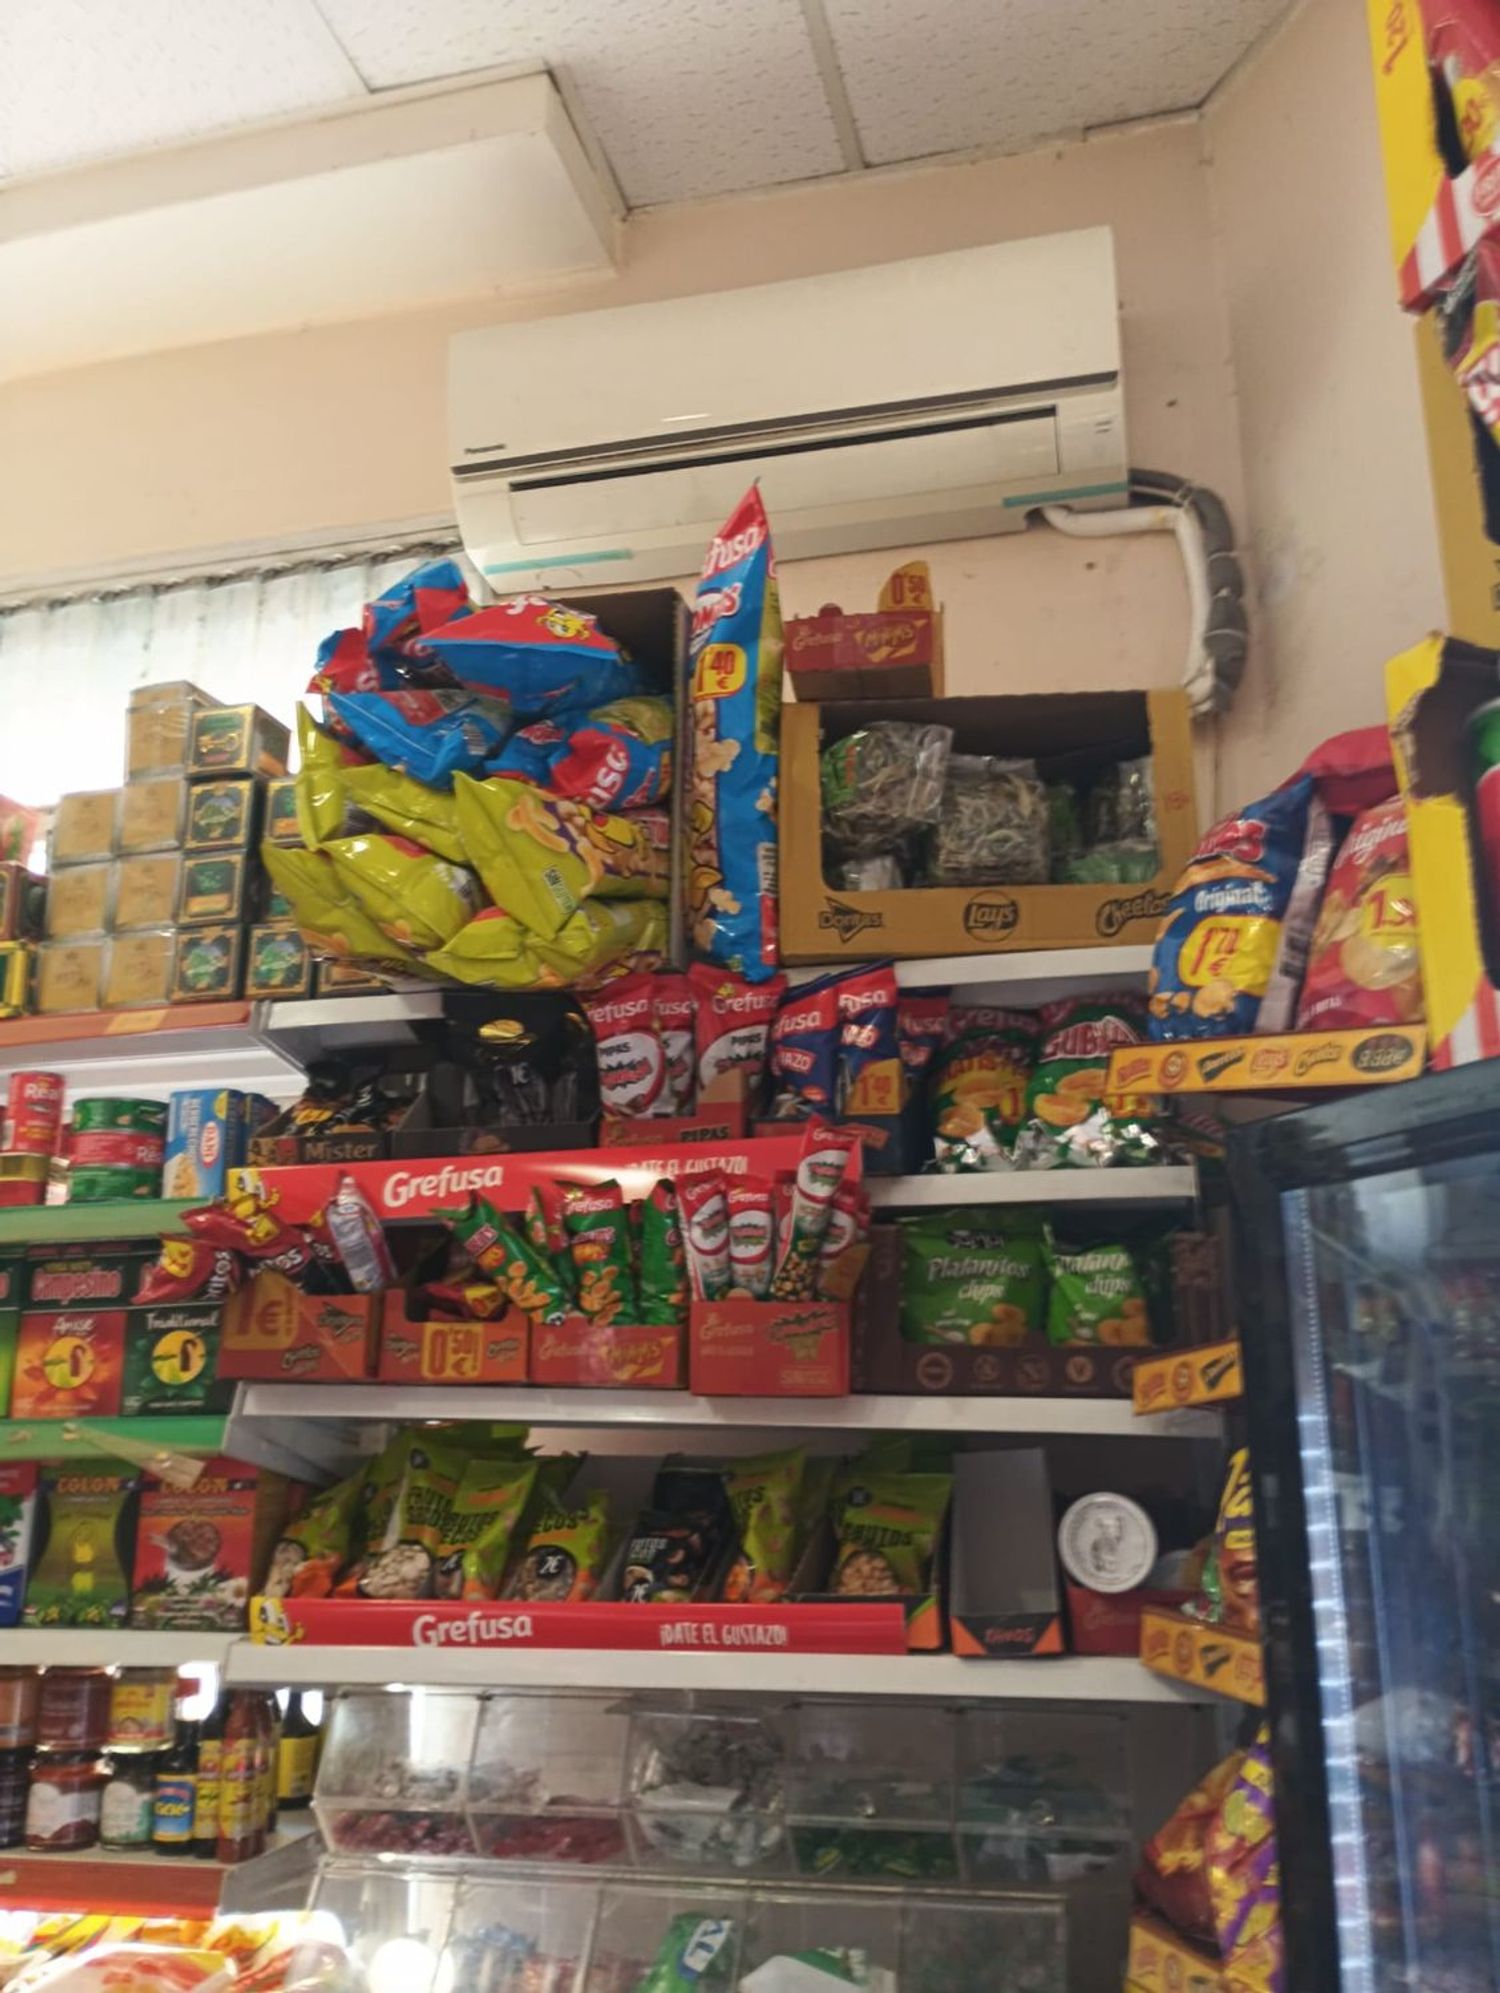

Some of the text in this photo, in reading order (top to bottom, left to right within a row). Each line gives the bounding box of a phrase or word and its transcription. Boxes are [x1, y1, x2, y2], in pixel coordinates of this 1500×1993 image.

[304, 1140, 378, 1161] Mister
[384, 1165, 503, 1208] Grefusa
[412, 1611, 533, 1648] Grefusa
